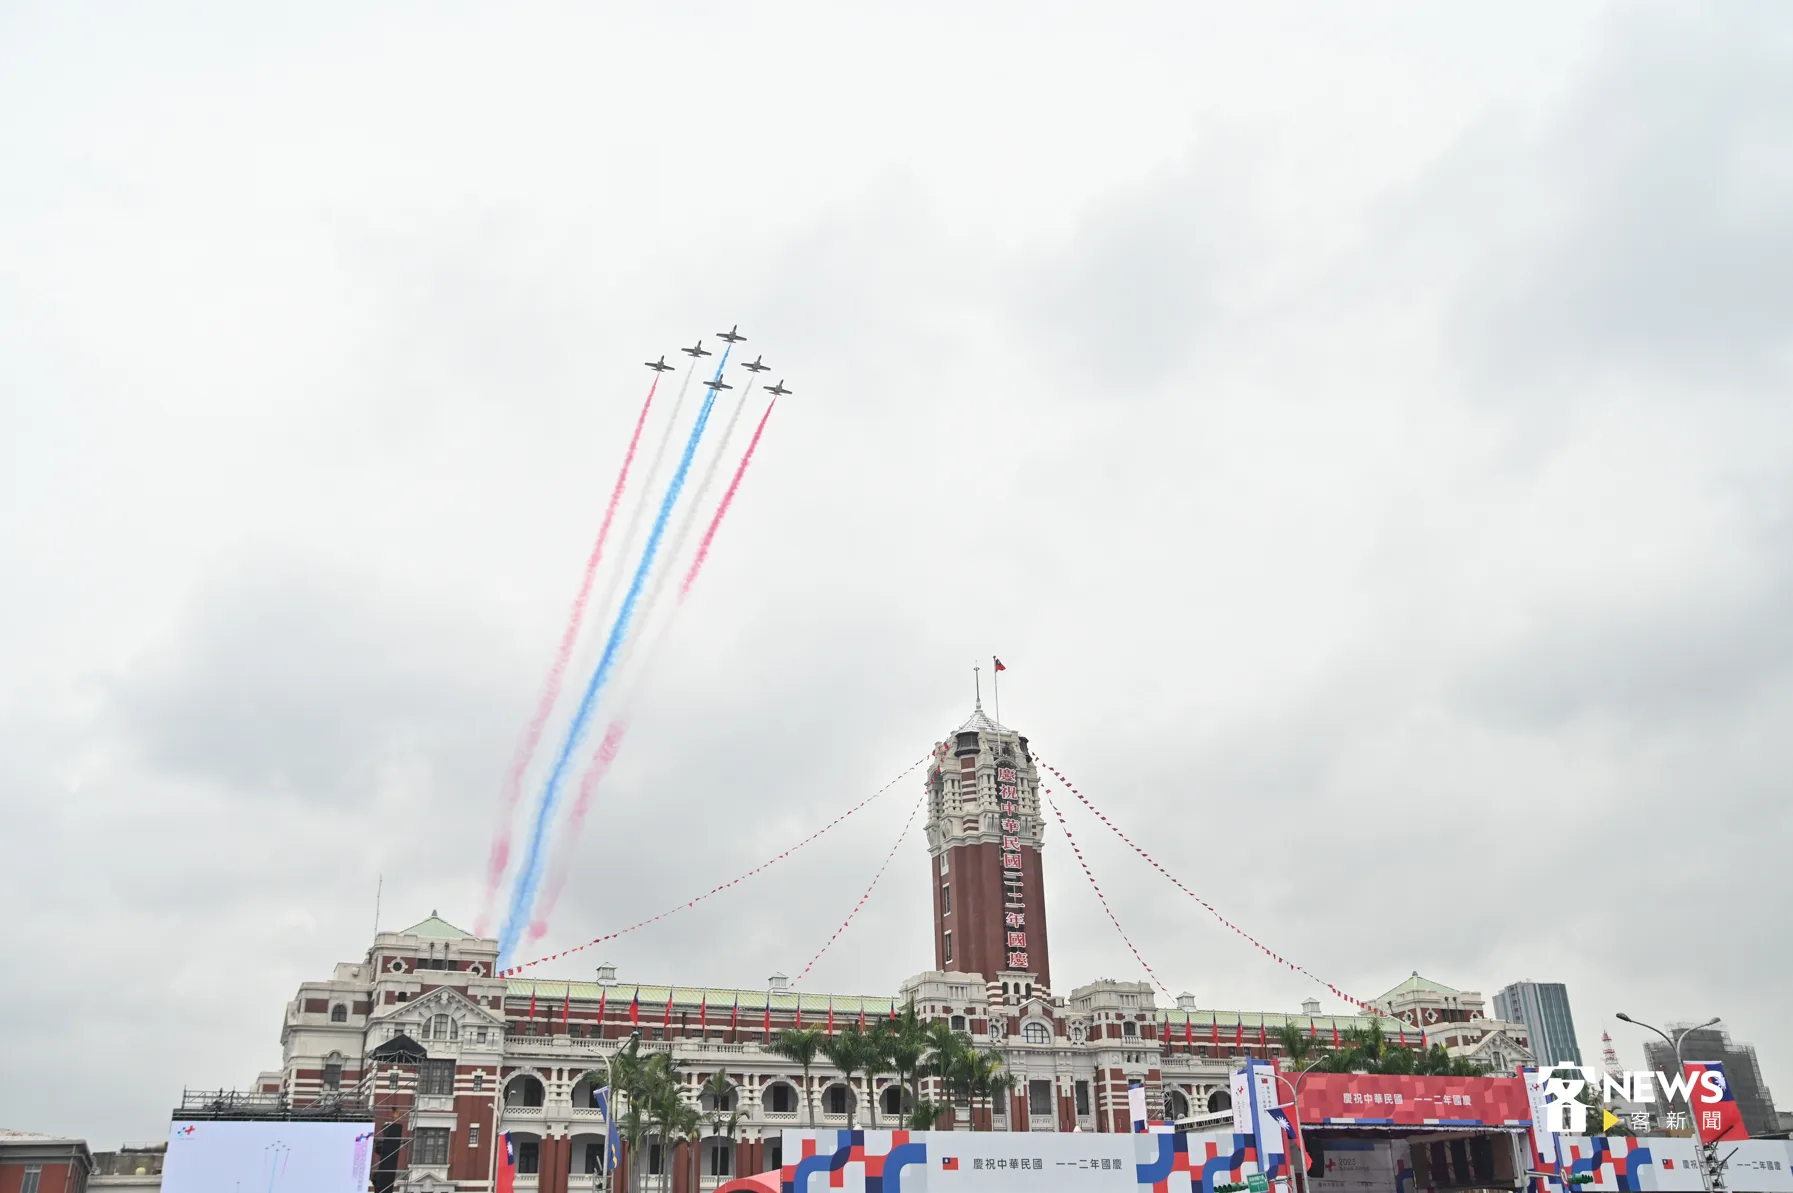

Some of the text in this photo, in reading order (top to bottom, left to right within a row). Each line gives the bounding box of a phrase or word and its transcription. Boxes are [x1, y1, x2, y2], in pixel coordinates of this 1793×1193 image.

[997, 768, 1029, 968] 慶祝中華民國一一二年國慶
[1343, 1093, 1472, 1106] 慶祝中華民國 一一二年國慶
[973, 1158, 1123, 1170] 慶祝中華民國 一一二年國慶
[1338, 1158, 1357, 1166] 2023
[1736, 1160, 1782, 1171] 一一二年國慶
